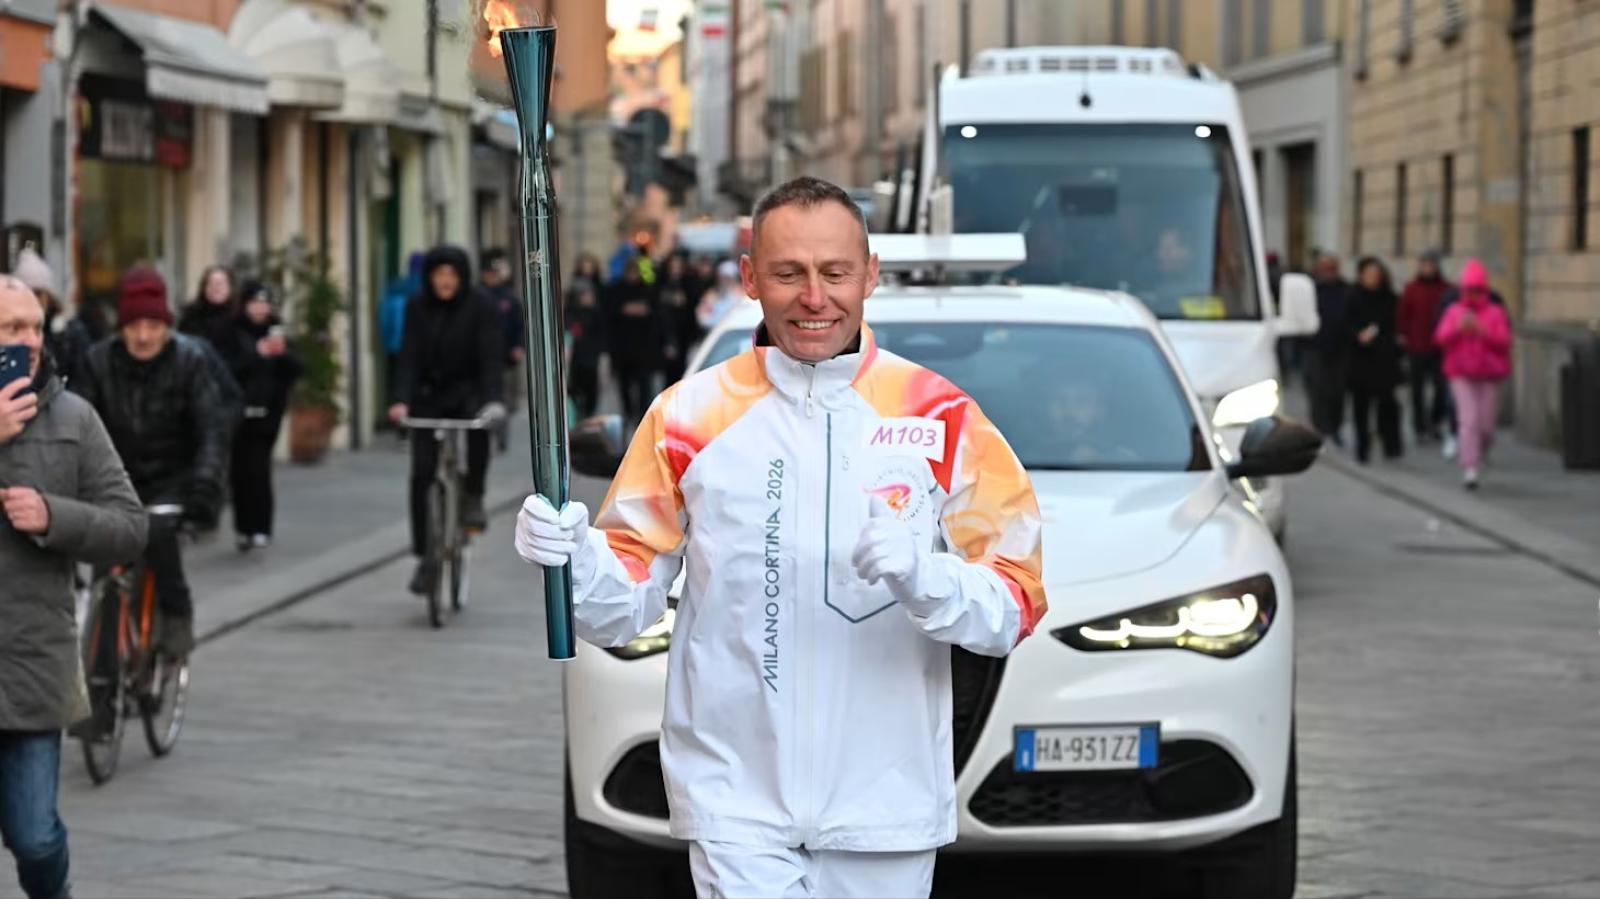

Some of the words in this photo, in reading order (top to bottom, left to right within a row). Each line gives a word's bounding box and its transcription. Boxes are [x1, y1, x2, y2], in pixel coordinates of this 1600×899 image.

[870, 425, 937, 447] M103
[767, 458, 785, 501] 2026
[764, 506, 781, 599] CORTINA
[763, 603, 780, 694] MILANO
